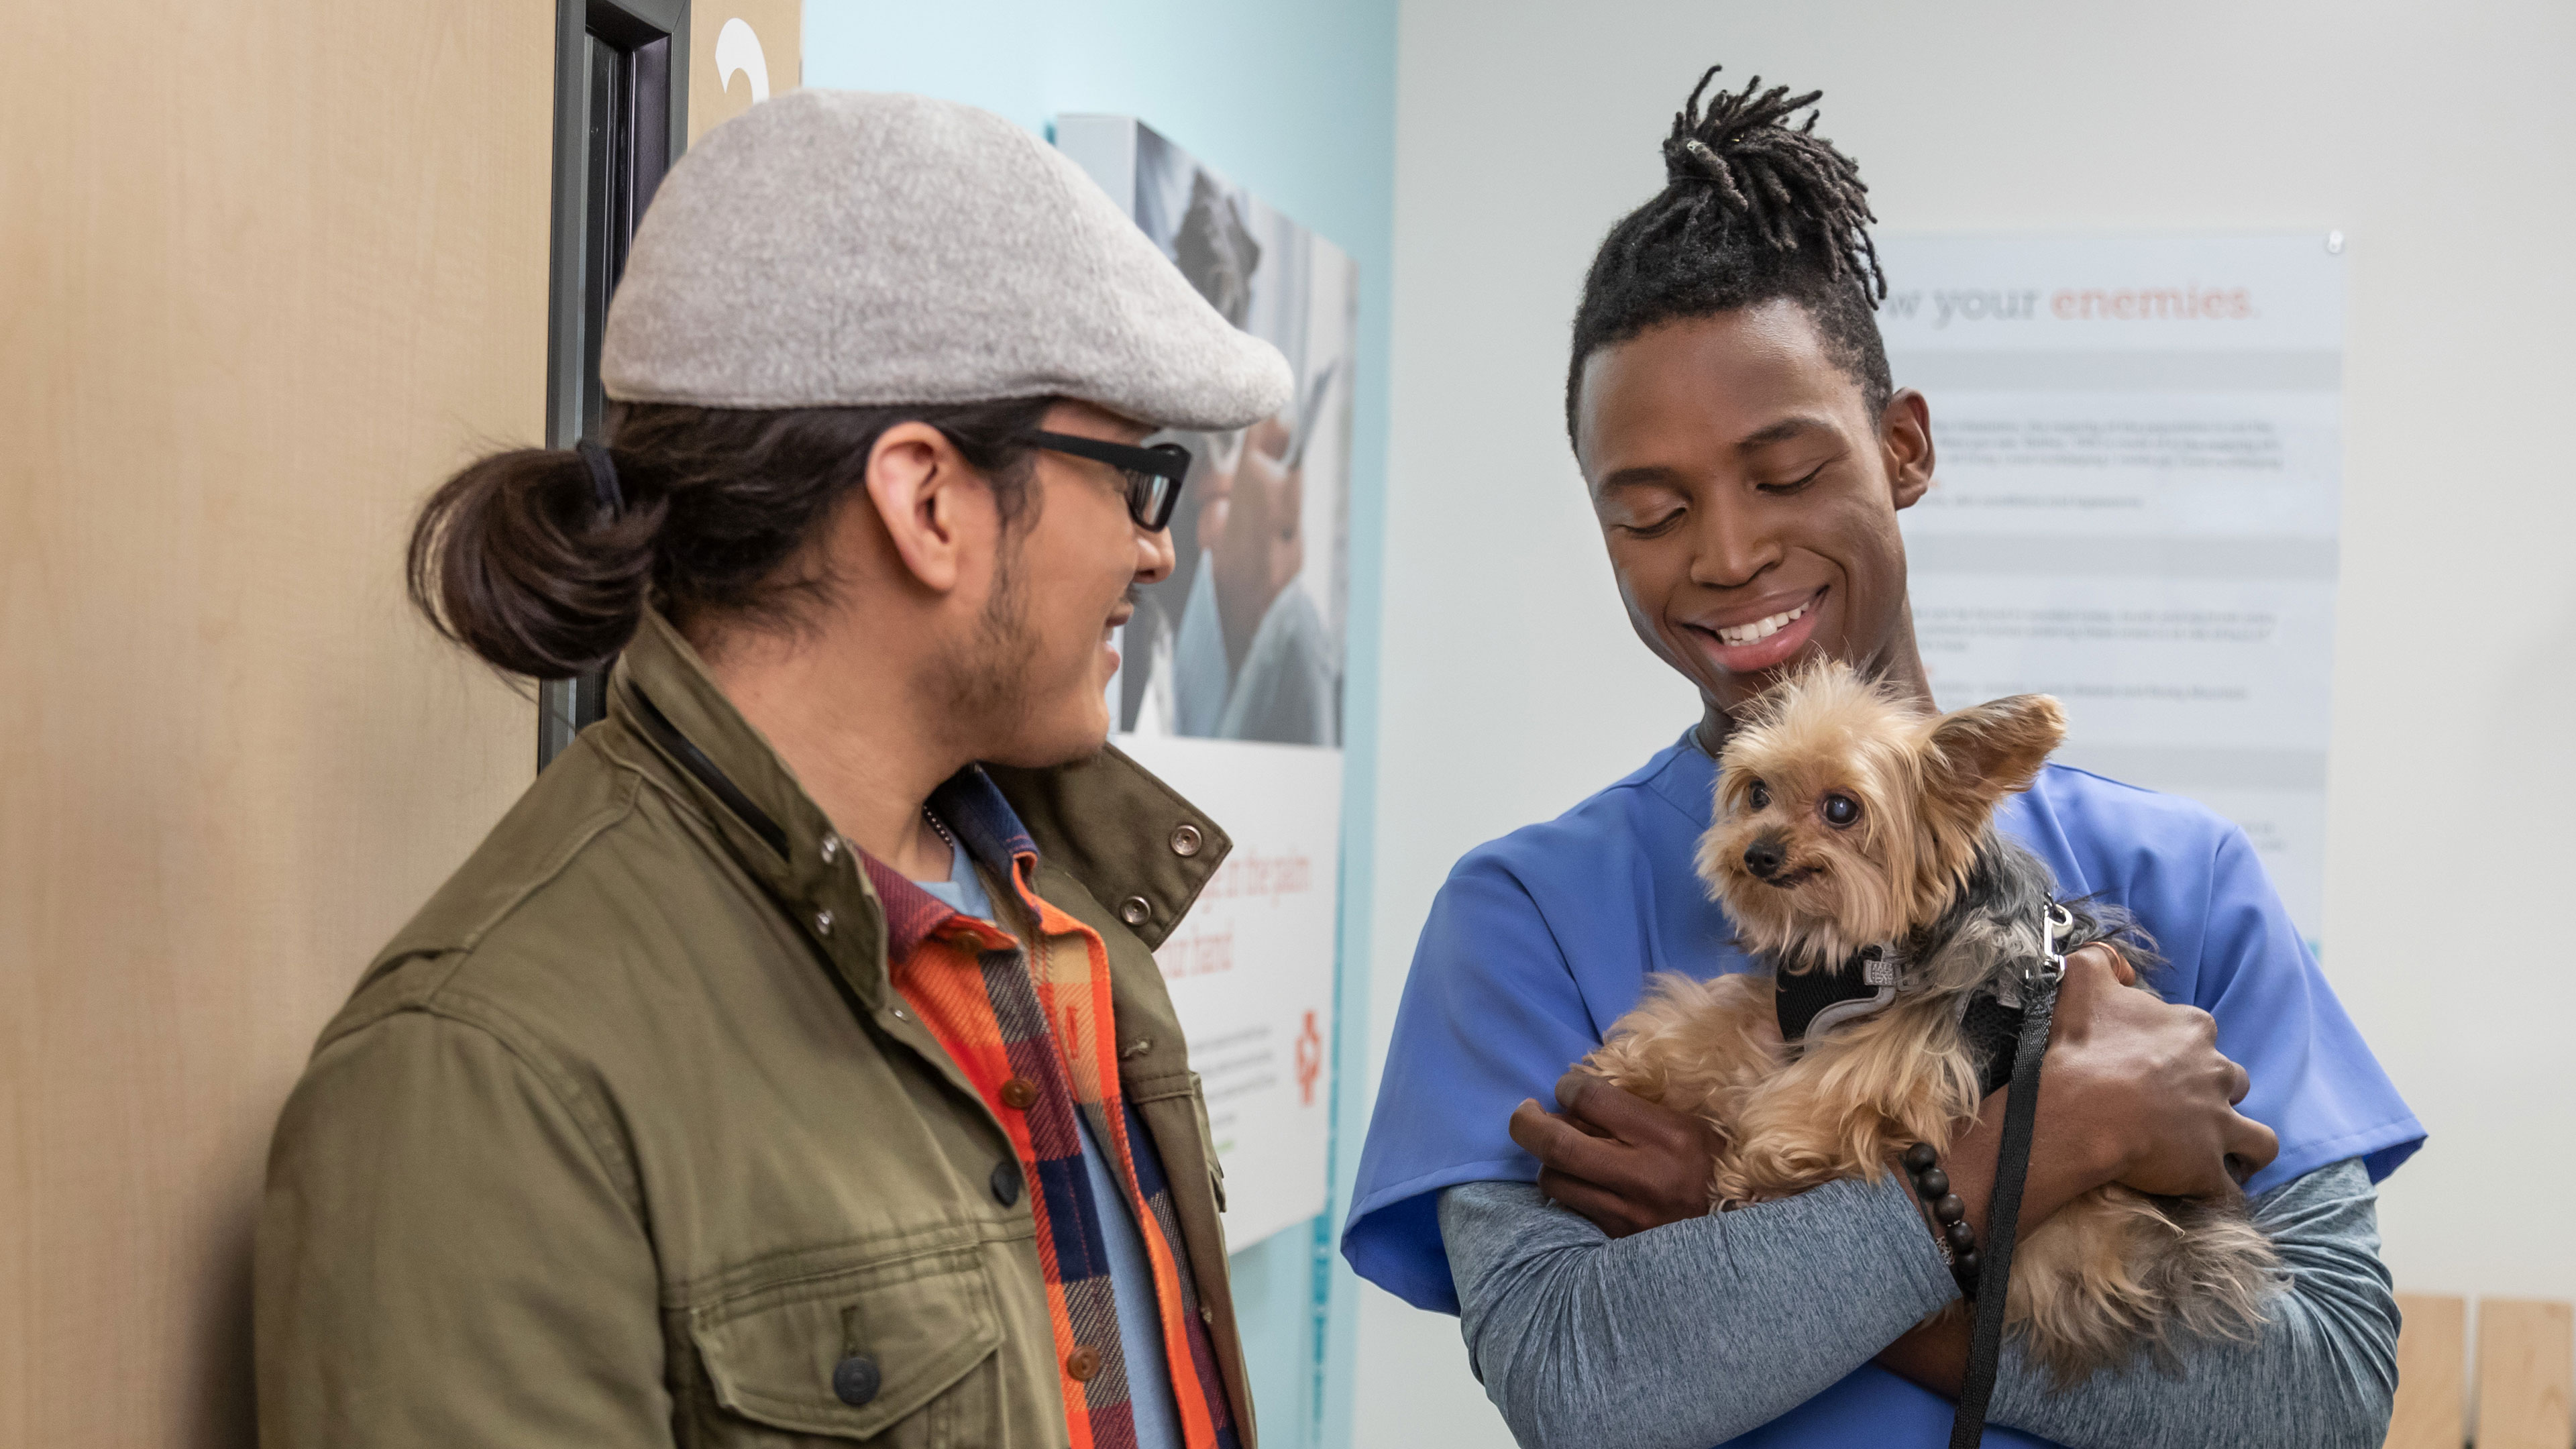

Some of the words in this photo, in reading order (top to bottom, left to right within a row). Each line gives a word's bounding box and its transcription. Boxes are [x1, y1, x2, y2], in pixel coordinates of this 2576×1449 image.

[1931, 288, 2041, 330] your
[2049, 279, 2261, 321] enemies.
[1245, 847, 1268, 896] the
[1191, 920, 1234, 975] hand
